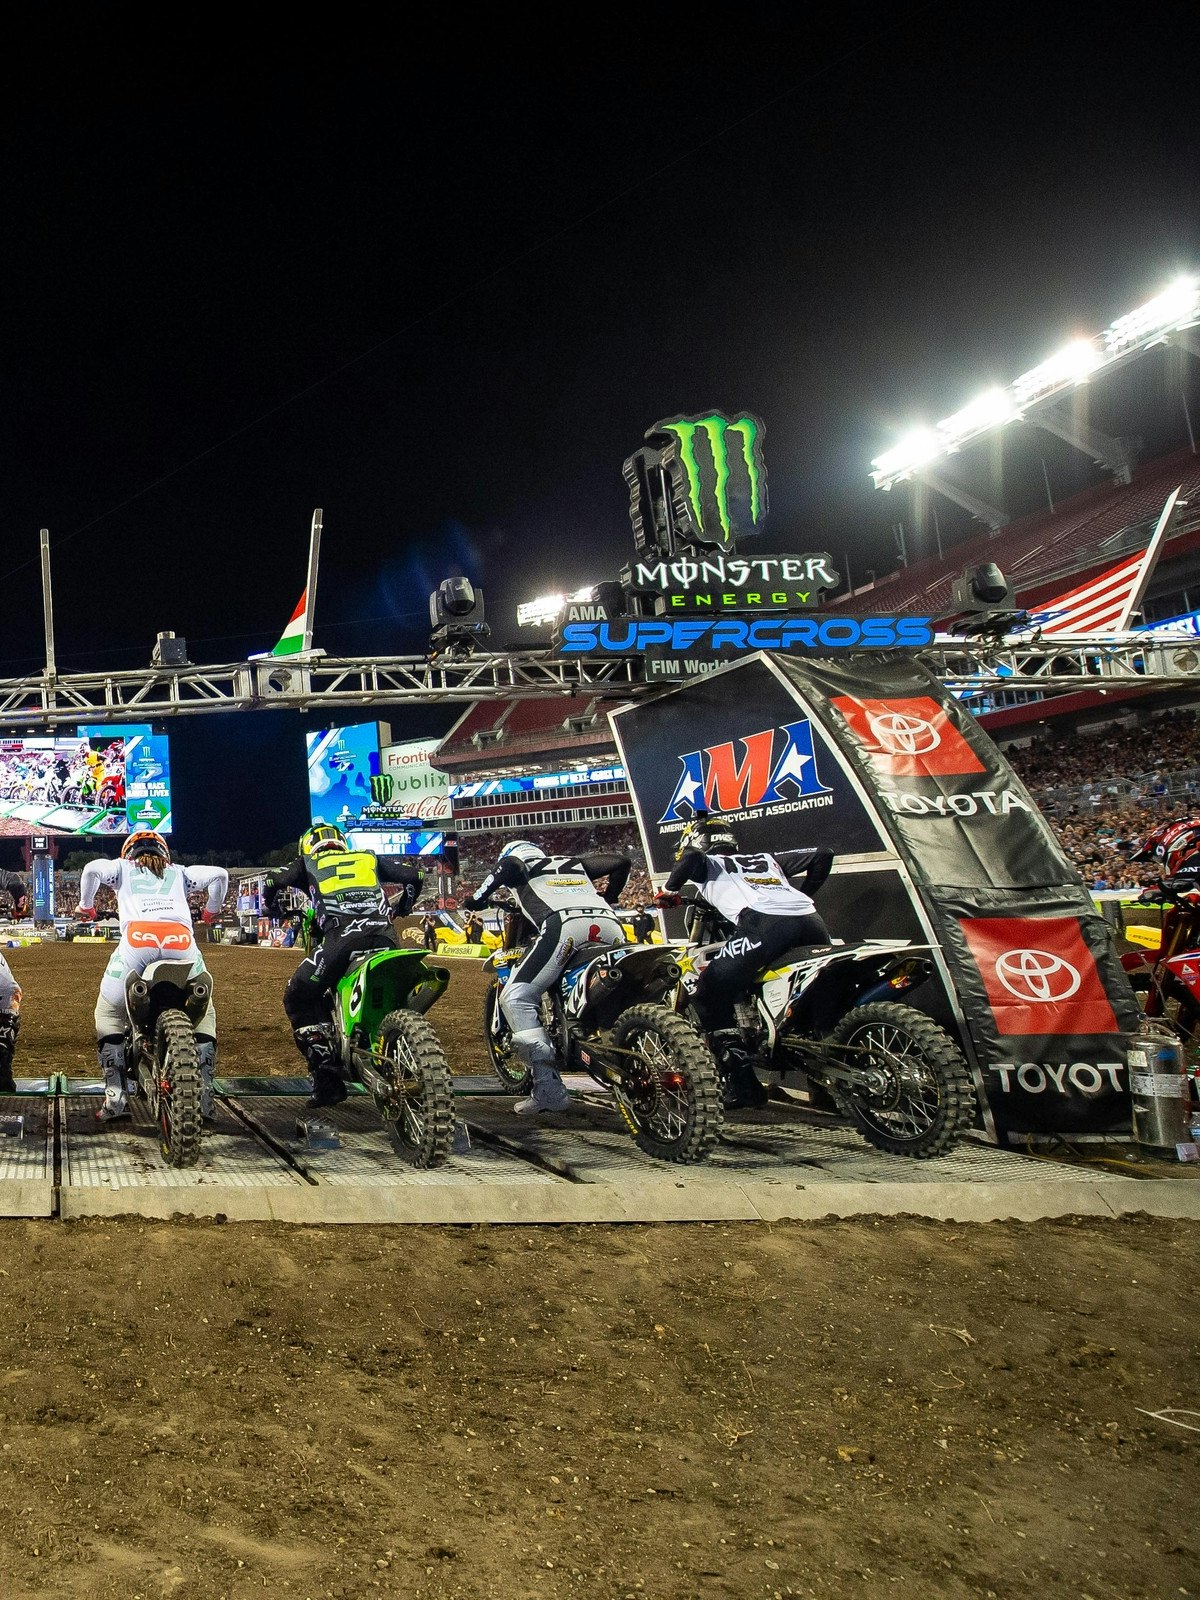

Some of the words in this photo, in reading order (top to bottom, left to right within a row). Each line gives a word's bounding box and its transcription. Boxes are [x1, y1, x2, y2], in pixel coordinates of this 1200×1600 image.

[635, 555, 835, 590] MONSTER
[671, 592, 811, 607] ENERGY
[568, 605, 607, 621] AMA
[560, 617, 933, 652] SUPERCROSS
[652, 660, 681, 674] FIM
[657, 718, 834, 824] AMA
[391, 773, 447, 791] ublix
[766, 796, 834, 816] ASSOCIATION
[878, 790, 1032, 816] TOYOTA
[130, 869, 177, 895] 27
[317, 853, 377, 895] 3
[340, 901, 377, 911] Kawasaki
[131, 931, 190, 949] seven
[442, 945, 473, 955] Kawasaki
[989, 1063, 1124, 1094] TOYOT
